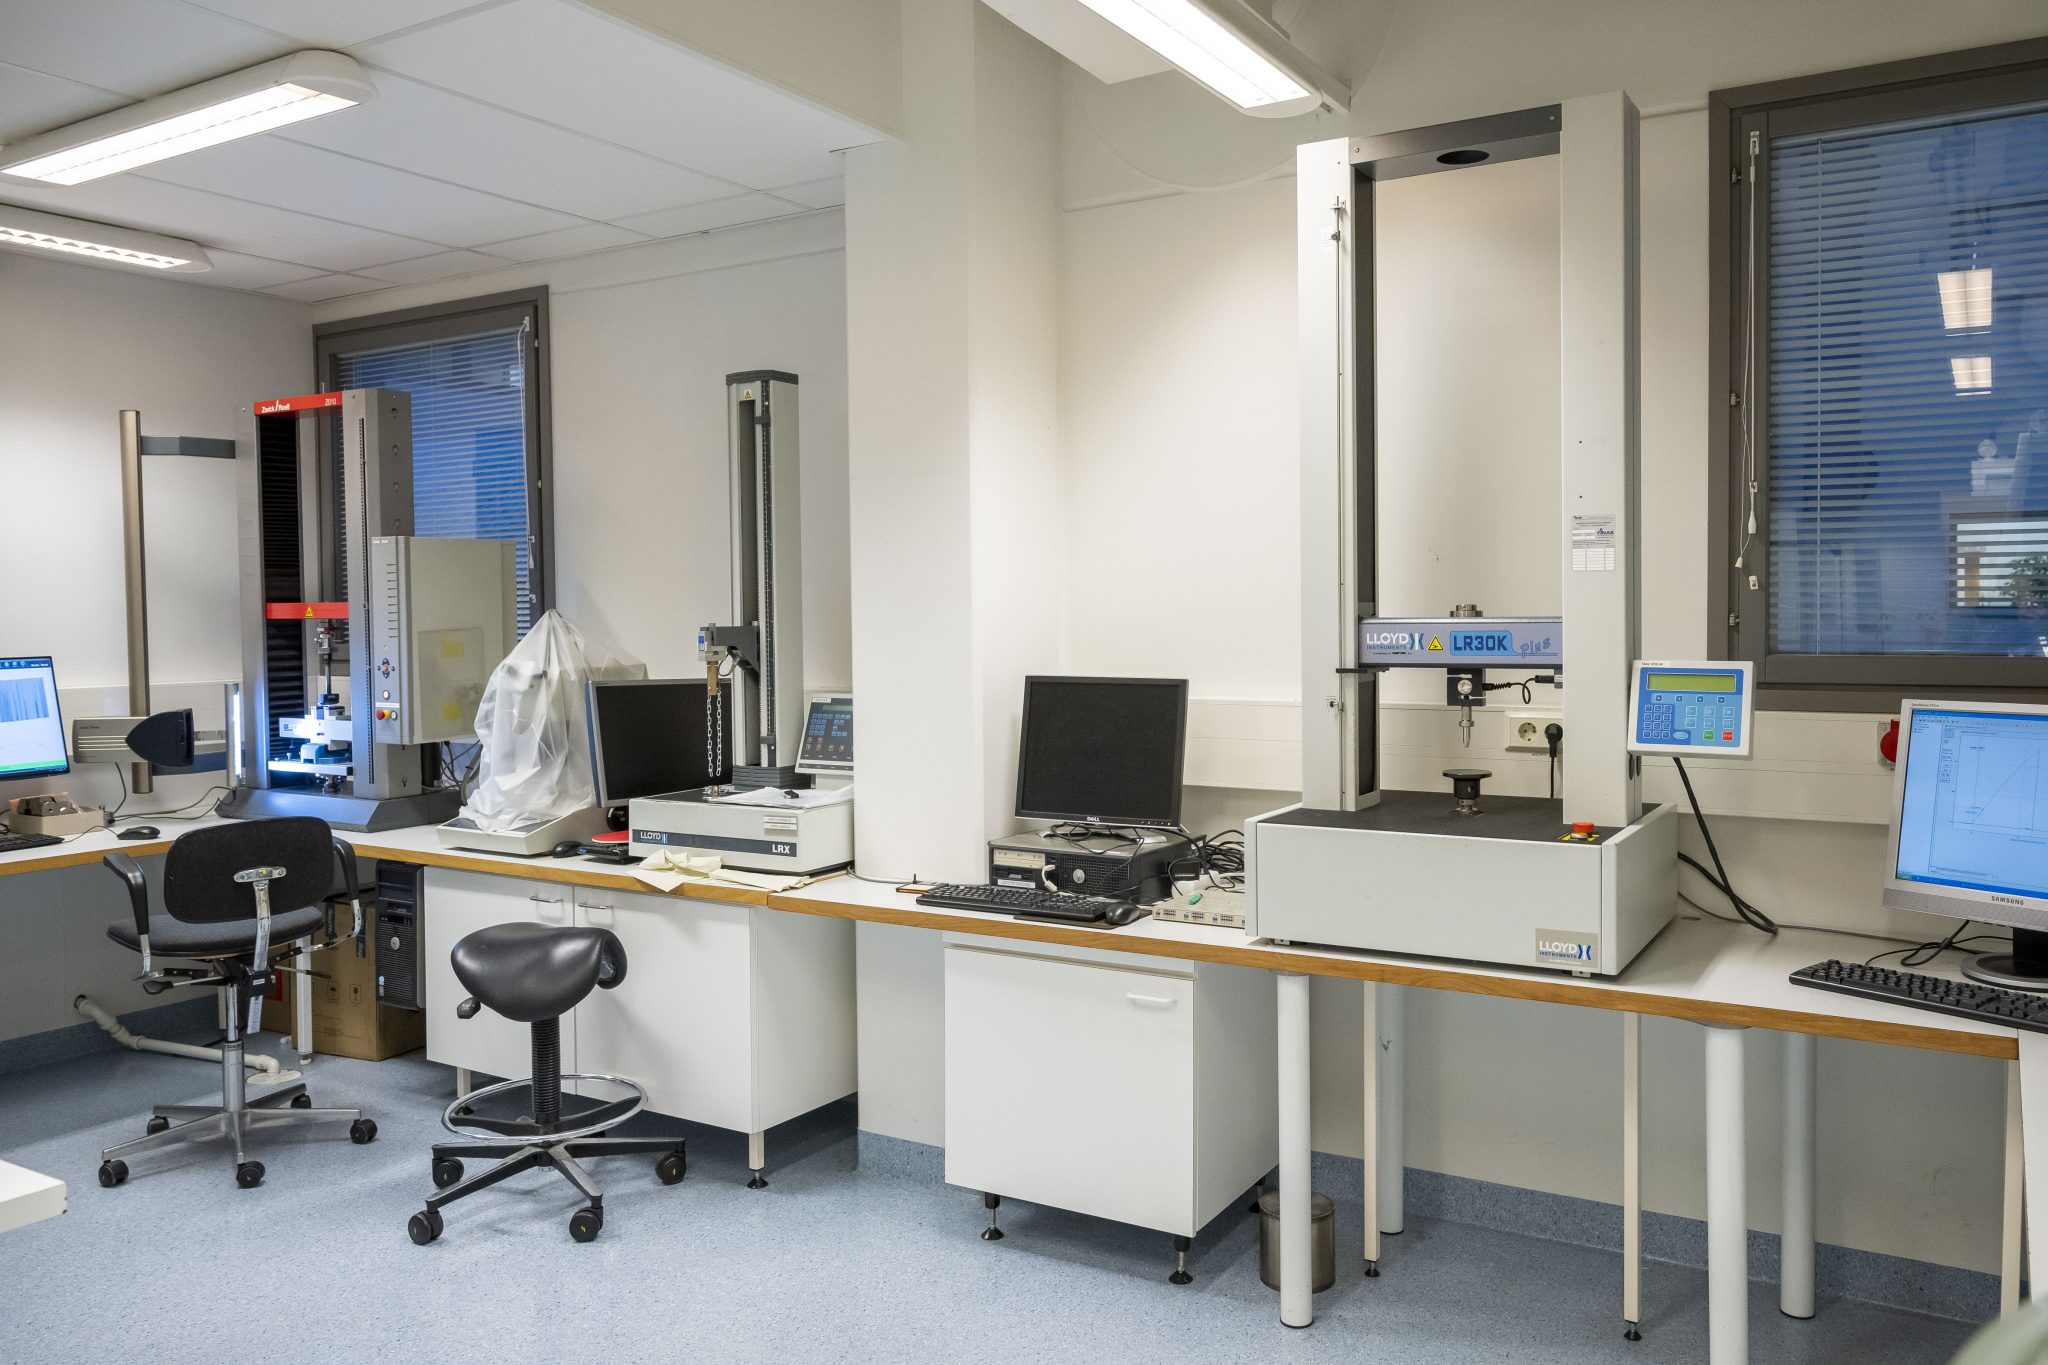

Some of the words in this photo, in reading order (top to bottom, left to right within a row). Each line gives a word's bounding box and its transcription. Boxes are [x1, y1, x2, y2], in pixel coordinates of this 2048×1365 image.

[1366, 632, 1409, 645] LLOYD
[1453, 635, 1508, 651] LR30K
[1520, 637, 1551, 658] plus
[640, 831, 661, 840] LLOYD
[772, 843, 790, 854] LRX
[1991, 895, 2025, 906] SAMSUNG
[1539, 940, 1578, 954] LLOYD
[1539, 951, 1578, 959] INSTRUMENTS
